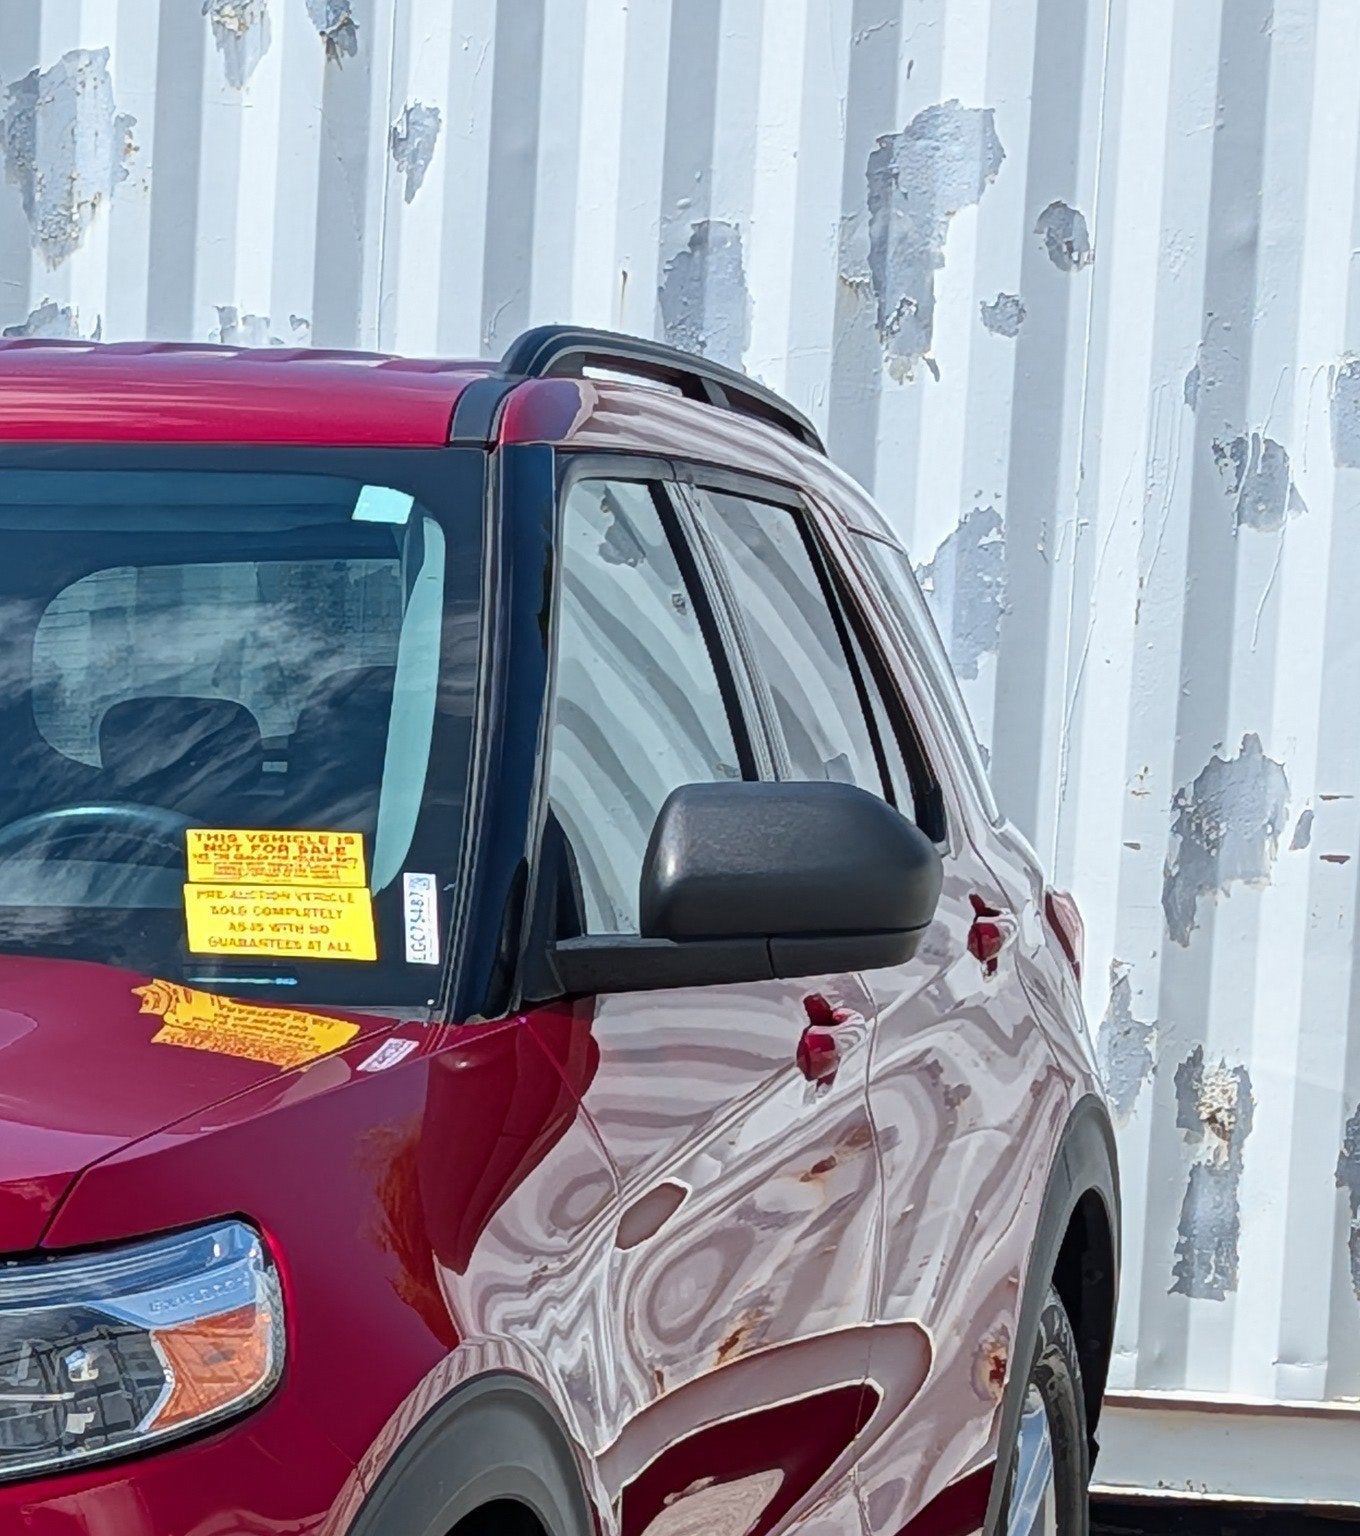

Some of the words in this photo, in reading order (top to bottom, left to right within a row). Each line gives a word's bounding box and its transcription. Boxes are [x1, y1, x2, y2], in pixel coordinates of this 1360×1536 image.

[194, 832, 238, 843] THIS
[245, 833, 330, 845] VEHICLE
[337, 834, 355, 845] IS
[203, 843, 243, 852] NOT
[250, 844, 289, 854] FOR
[298, 845, 346, 855] SALE
[252, 905, 344, 920] COMPLETELY
[228, 922, 247, 932] AS
[327, 941, 353, 952] ALL
